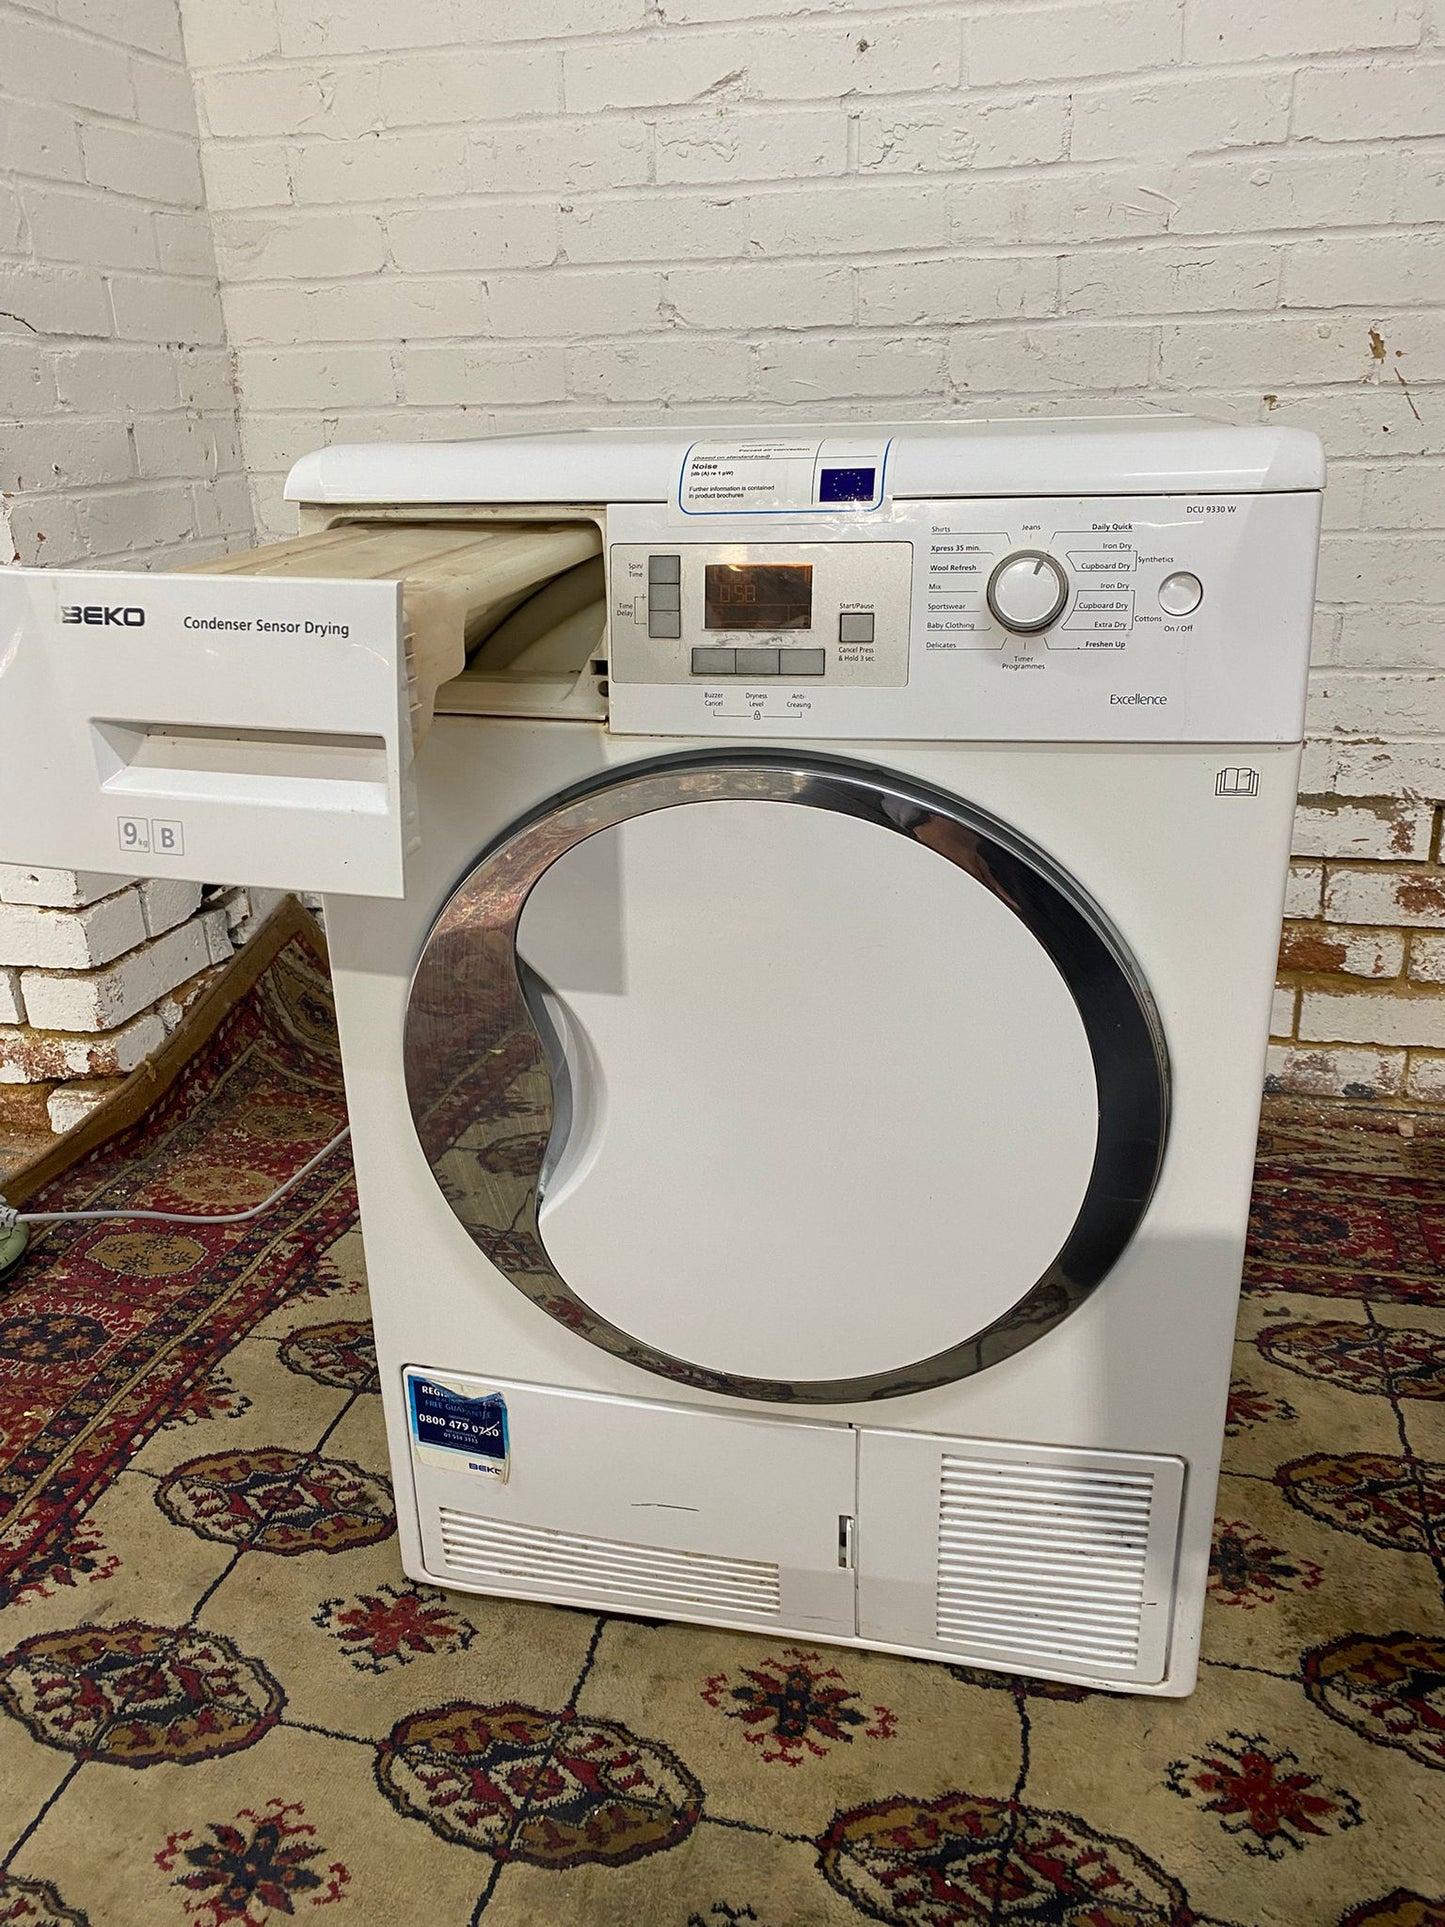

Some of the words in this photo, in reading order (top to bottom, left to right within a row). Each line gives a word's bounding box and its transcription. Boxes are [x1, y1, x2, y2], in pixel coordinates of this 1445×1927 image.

[1186, 505, 1203, 513] DCU
[1206, 505, 1226, 513] 9330
[931, 525, 951, 533] Shirts
[1092, 523, 1110, 532] Daily
[1112, 522, 1133, 531] Quick
[931, 545, 954, 553] Xpress
[956, 544, 964, 552] 35
[1102, 542, 1117, 550] Iron
[1118, 542, 1132, 551] Dry
[1138, 555, 1174, 564] Synthetics
[930, 564, 949, 572] Wool
[950, 564, 977, 572] Refresh
[1081, 562, 1116, 571] Cupboard
[1117, 562, 1131, 571] Dry
[928, 583, 941, 591] Mix
[1100, 582, 1115, 590] Iron
[1116, 582, 1130, 591] Dry
[839, 602, 875, 610] Start/Pause
[927, 603, 966, 611] Sportswear
[1078, 601, 1114, 610] Cupboard
[1115, 601, 1129, 610] Dry
[61, 606, 145, 627] BEKO
[616, 609, 634, 617] Delay
[183, 615, 252, 631] Condenser
[256, 618, 301, 634] Sensor
[304, 621, 350, 638] Drying
[926, 621, 943, 630] Baby
[945, 621, 975, 630] Clothing
[1094, 621, 1113, 629] Extra
[1113, 621, 1128, 630] Dry
[1180, 624, 1194, 632] Off
[926, 641, 957, 649] Delicates
[1085, 640, 1114, 648] Freshen
[1115, 640, 1126, 649] Up
[838, 646, 858, 654] Cancel
[1002, 662, 1046, 671] Programmes
[704, 691, 724, 699] Buzzer
[745, 692, 768, 700] Dryness
[1109, 693, 1168, 706] Excellence
[786, 701, 812, 709] Creasing
[160, 827, 175, 848] B
[418, 1414, 446, 1427] 0800
[448, 1420, 469, 1431] 479
